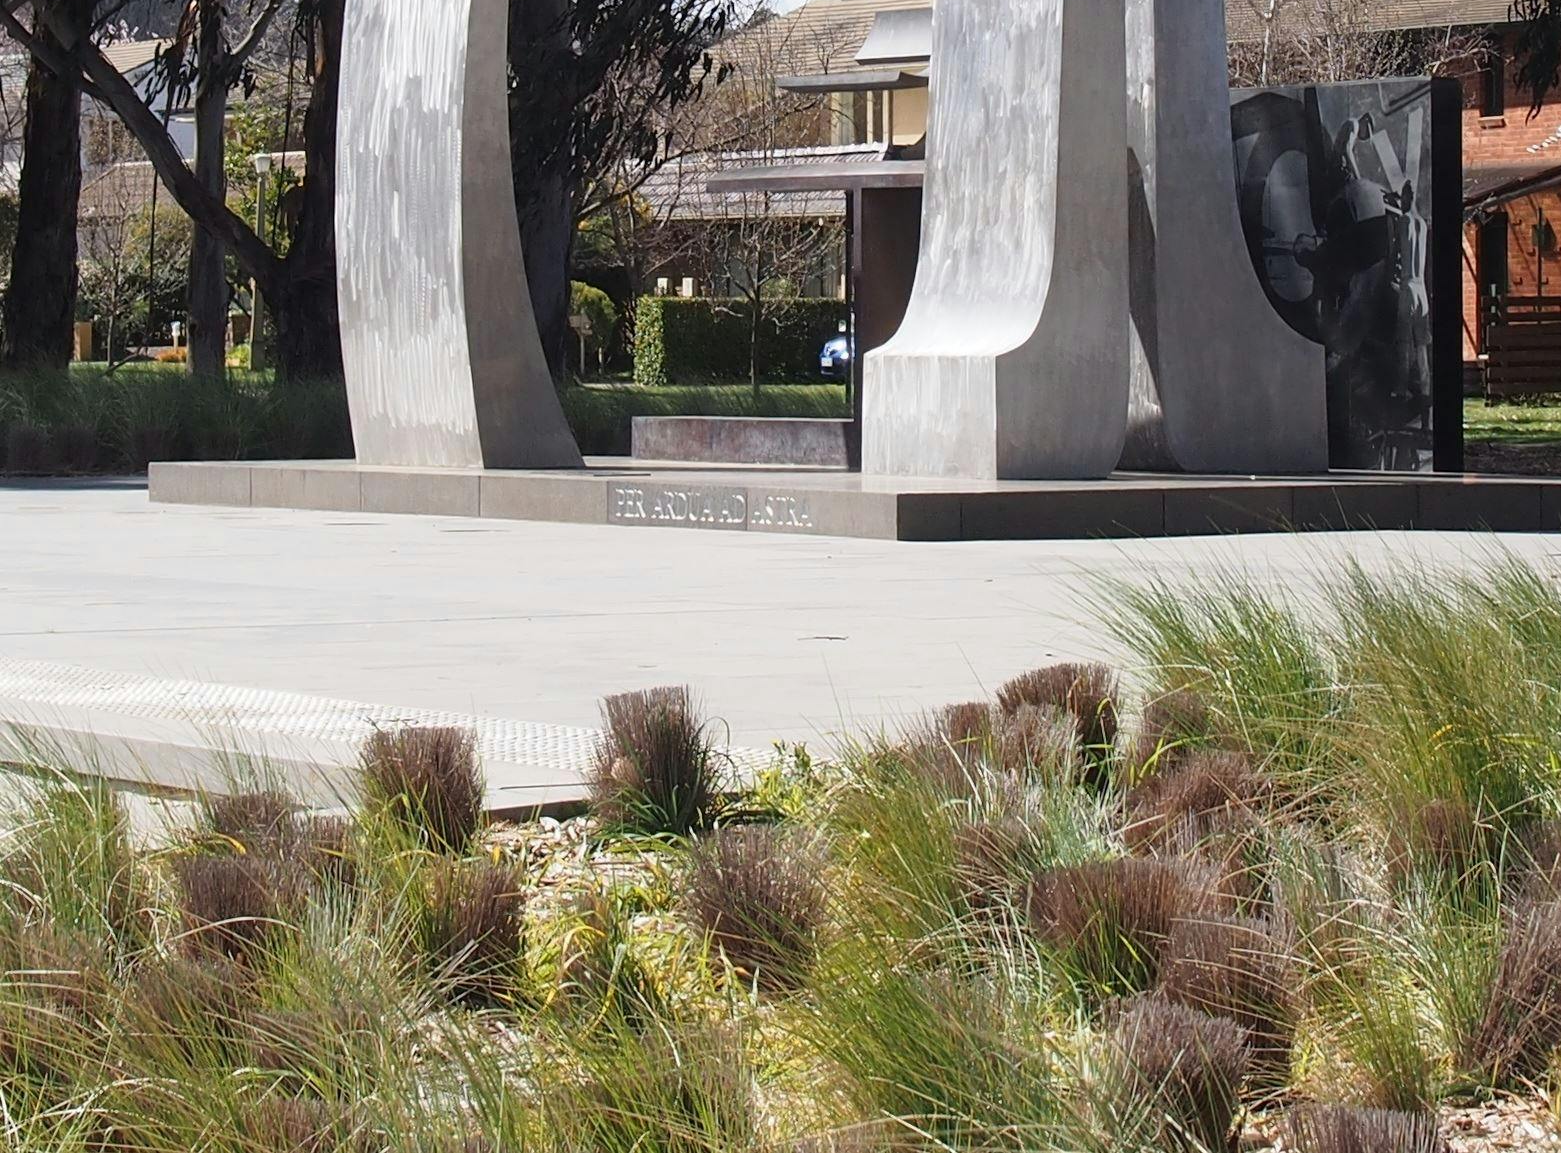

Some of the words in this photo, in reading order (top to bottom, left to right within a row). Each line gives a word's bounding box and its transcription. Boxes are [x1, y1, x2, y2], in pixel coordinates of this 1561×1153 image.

[615, 488, 646, 518] PER
[651, 491, 714, 522] ARDUA
[719, 493, 746, 523] AD
[751, 496, 813, 528] ASTRA
